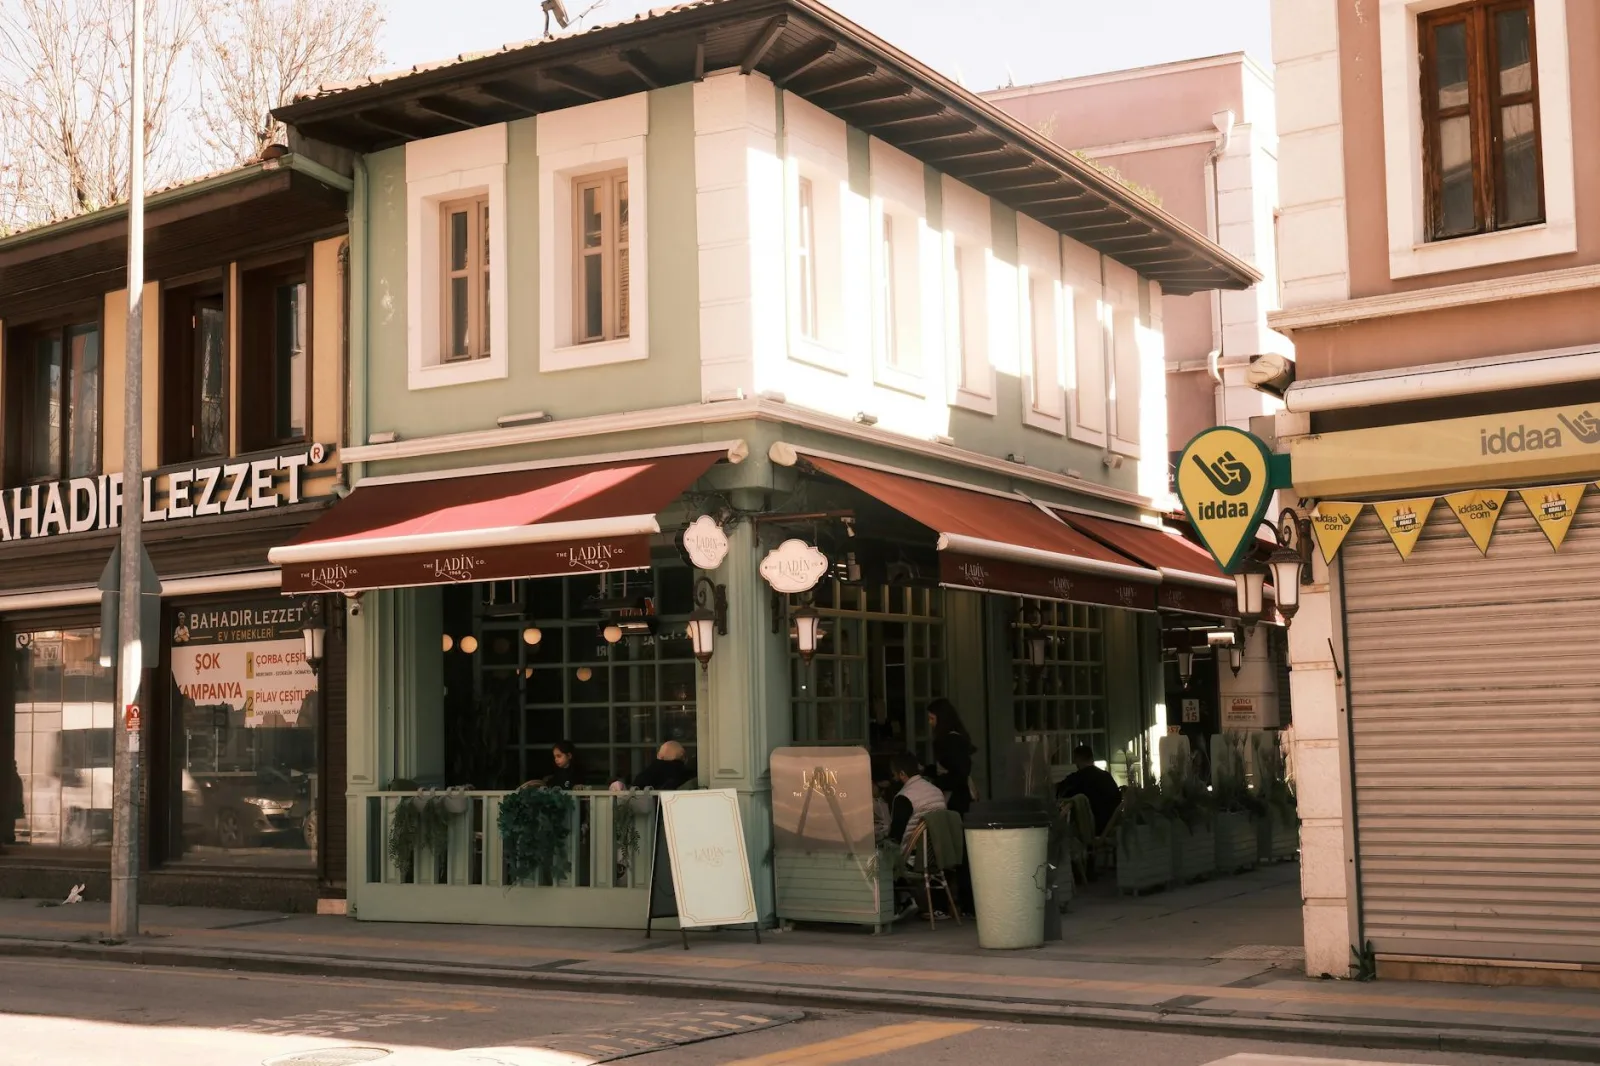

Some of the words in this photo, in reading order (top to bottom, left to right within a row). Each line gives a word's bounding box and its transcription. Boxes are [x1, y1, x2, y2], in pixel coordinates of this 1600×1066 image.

[1480, 424, 1562, 456] iddaa
[142, 451, 308, 522] LEZZET
[1198, 500, 1248, 520] iddaa
[1458, 503, 1484, 515] iddaa
[1469, 510, 1491, 520] com
[1324, 522, 1343, 531] com
[569, 542, 612, 562] LADİN
[435, 553, 475, 572] LADİN
[311, 563, 348, 583] LADİN
[190, 609, 252, 629] BAHADIR
[254, 607, 303, 625] LEZZET
[218, 631, 228, 642] EV
[231, 626, 275, 641] YEMEKLERİ
[195, 653, 221, 676] ŞOK
[256, 653, 283, 668] ÇORBA
[285, 649, 306, 666] ÇEŞİT
[247, 696, 254, 712] 2
[255, 688, 278, 703] PİLAV
[279, 684, 318, 705] ÇEŞİTLE
